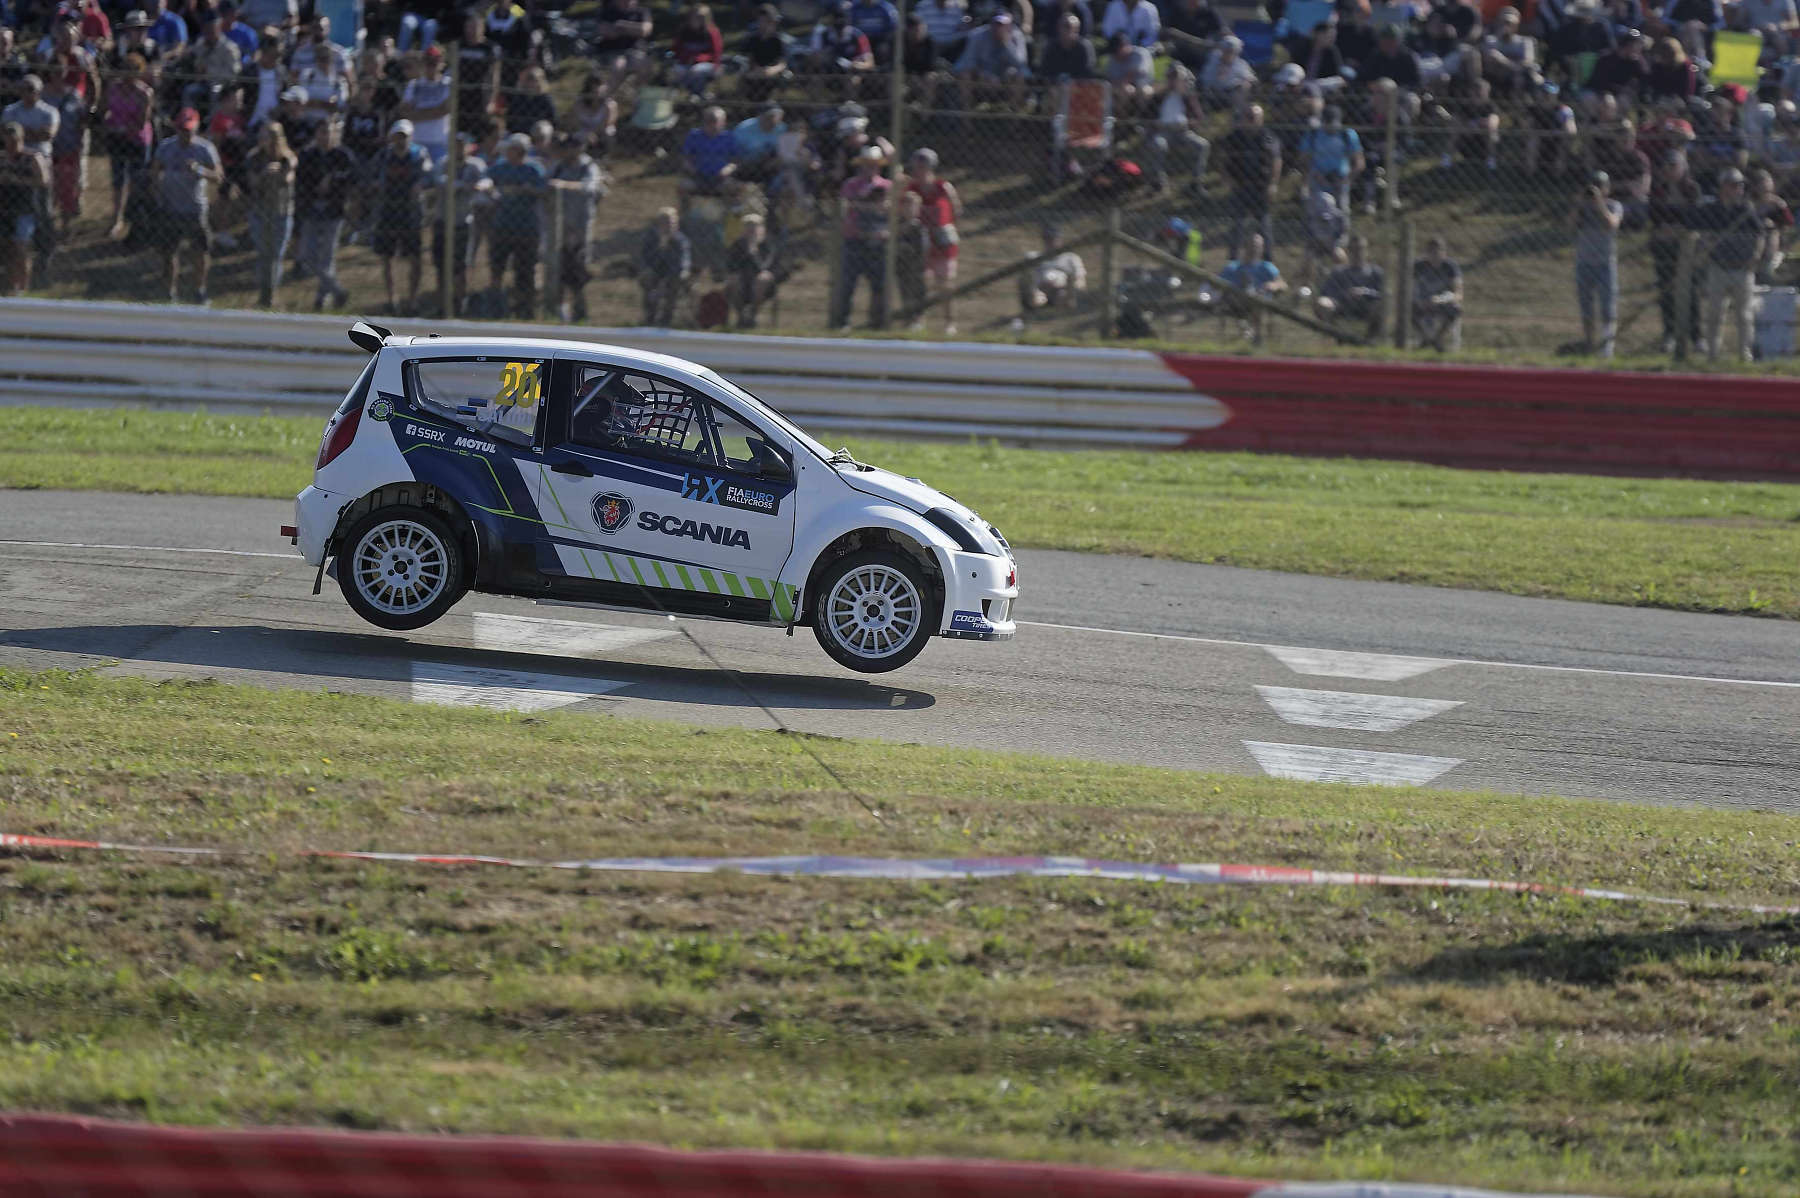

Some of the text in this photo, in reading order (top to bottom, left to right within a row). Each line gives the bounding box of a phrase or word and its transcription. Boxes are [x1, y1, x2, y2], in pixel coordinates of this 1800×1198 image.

[495, 369, 538, 408] 20
[417, 427, 446, 443] SSRX
[454, 436, 497, 454] MOTUL
[726, 495, 773, 509] RALLYCROSS
[637, 511, 752, 550] SCANIA
